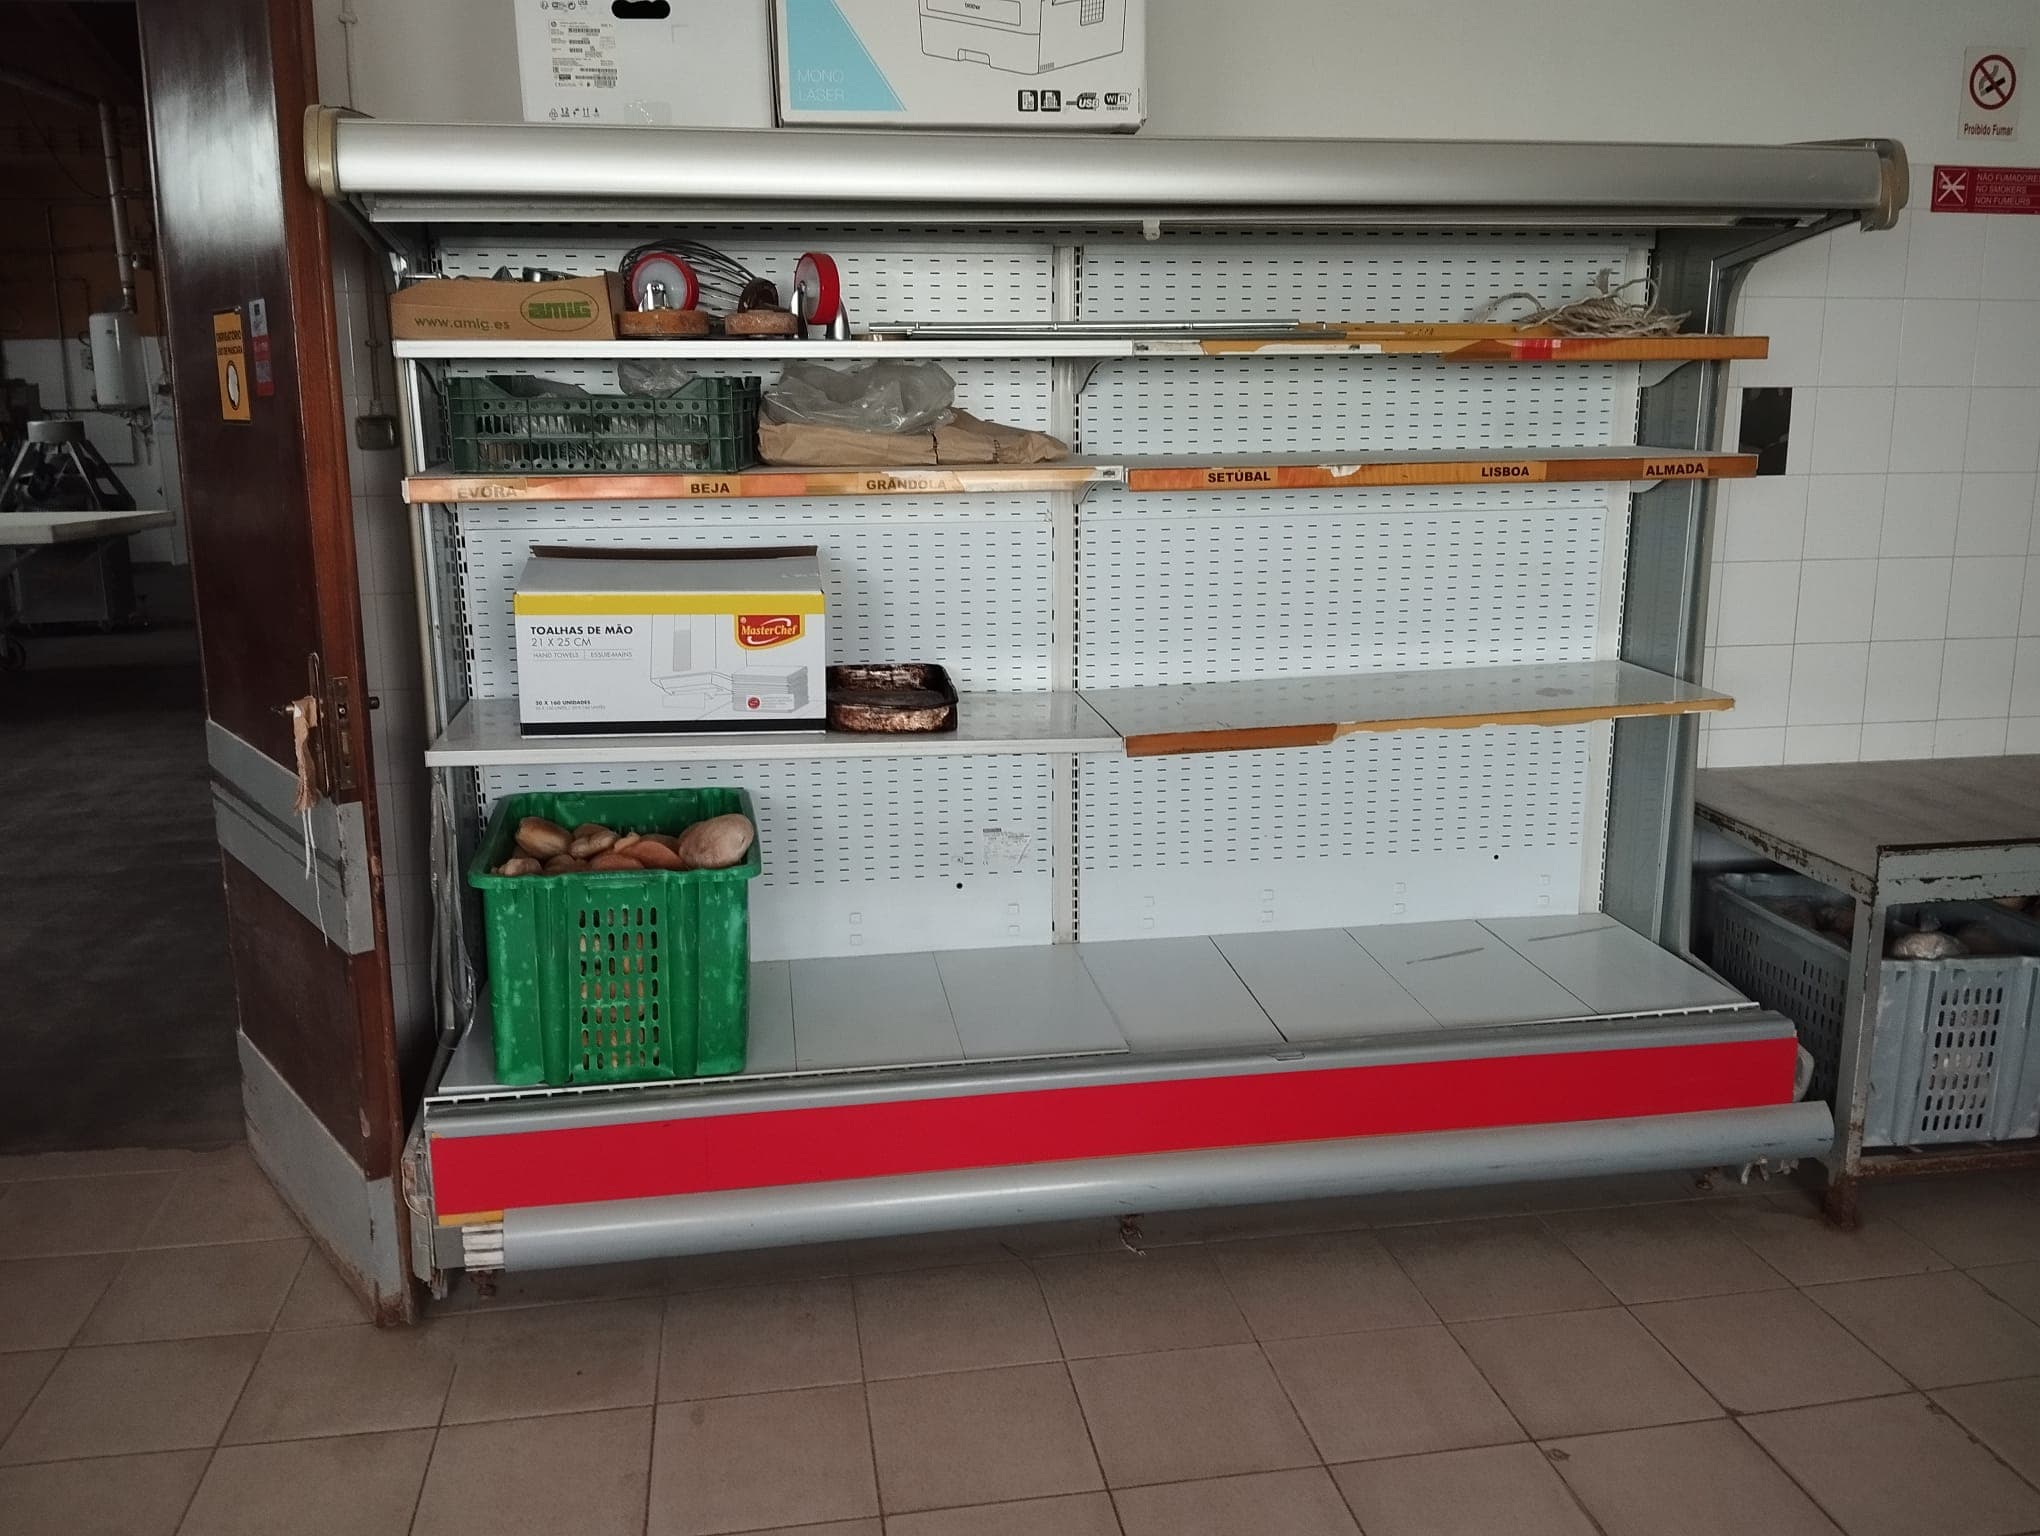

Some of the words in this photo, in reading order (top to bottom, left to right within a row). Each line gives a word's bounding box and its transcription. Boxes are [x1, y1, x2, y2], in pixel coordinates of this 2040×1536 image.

[797, 68, 845, 82] MONO
[799, 87, 845, 102] LASER
[1963, 123, 1991, 135] Proibido
[1992, 124, 2013, 136] Fumar
[1976, 172, 1994, 182] NÃO
[1995, 173, 2040, 184] FUMADORE
[1975, 184, 1988, 193] NO
[1974, 196, 1992, 205] NON
[414, 316, 512, 332] www.amig.es
[1207, 469, 1272, 484] SETÚBAL
[1480, 465, 1530, 478] LISBOA
[1645, 463, 1705, 477] ALMADA
[690, 482, 731, 495] BEJA
[530, 626, 584, 635] TOALHAS
[587, 626, 601, 635] DE
[605, 624, 633, 635] MÃO
[741, 624, 798, 636] MasterChef
[531, 637, 543, 647] 21
[547, 638, 554, 647] X
[558, 638, 571, 647] 25
[573, 637, 592, 647] CM
